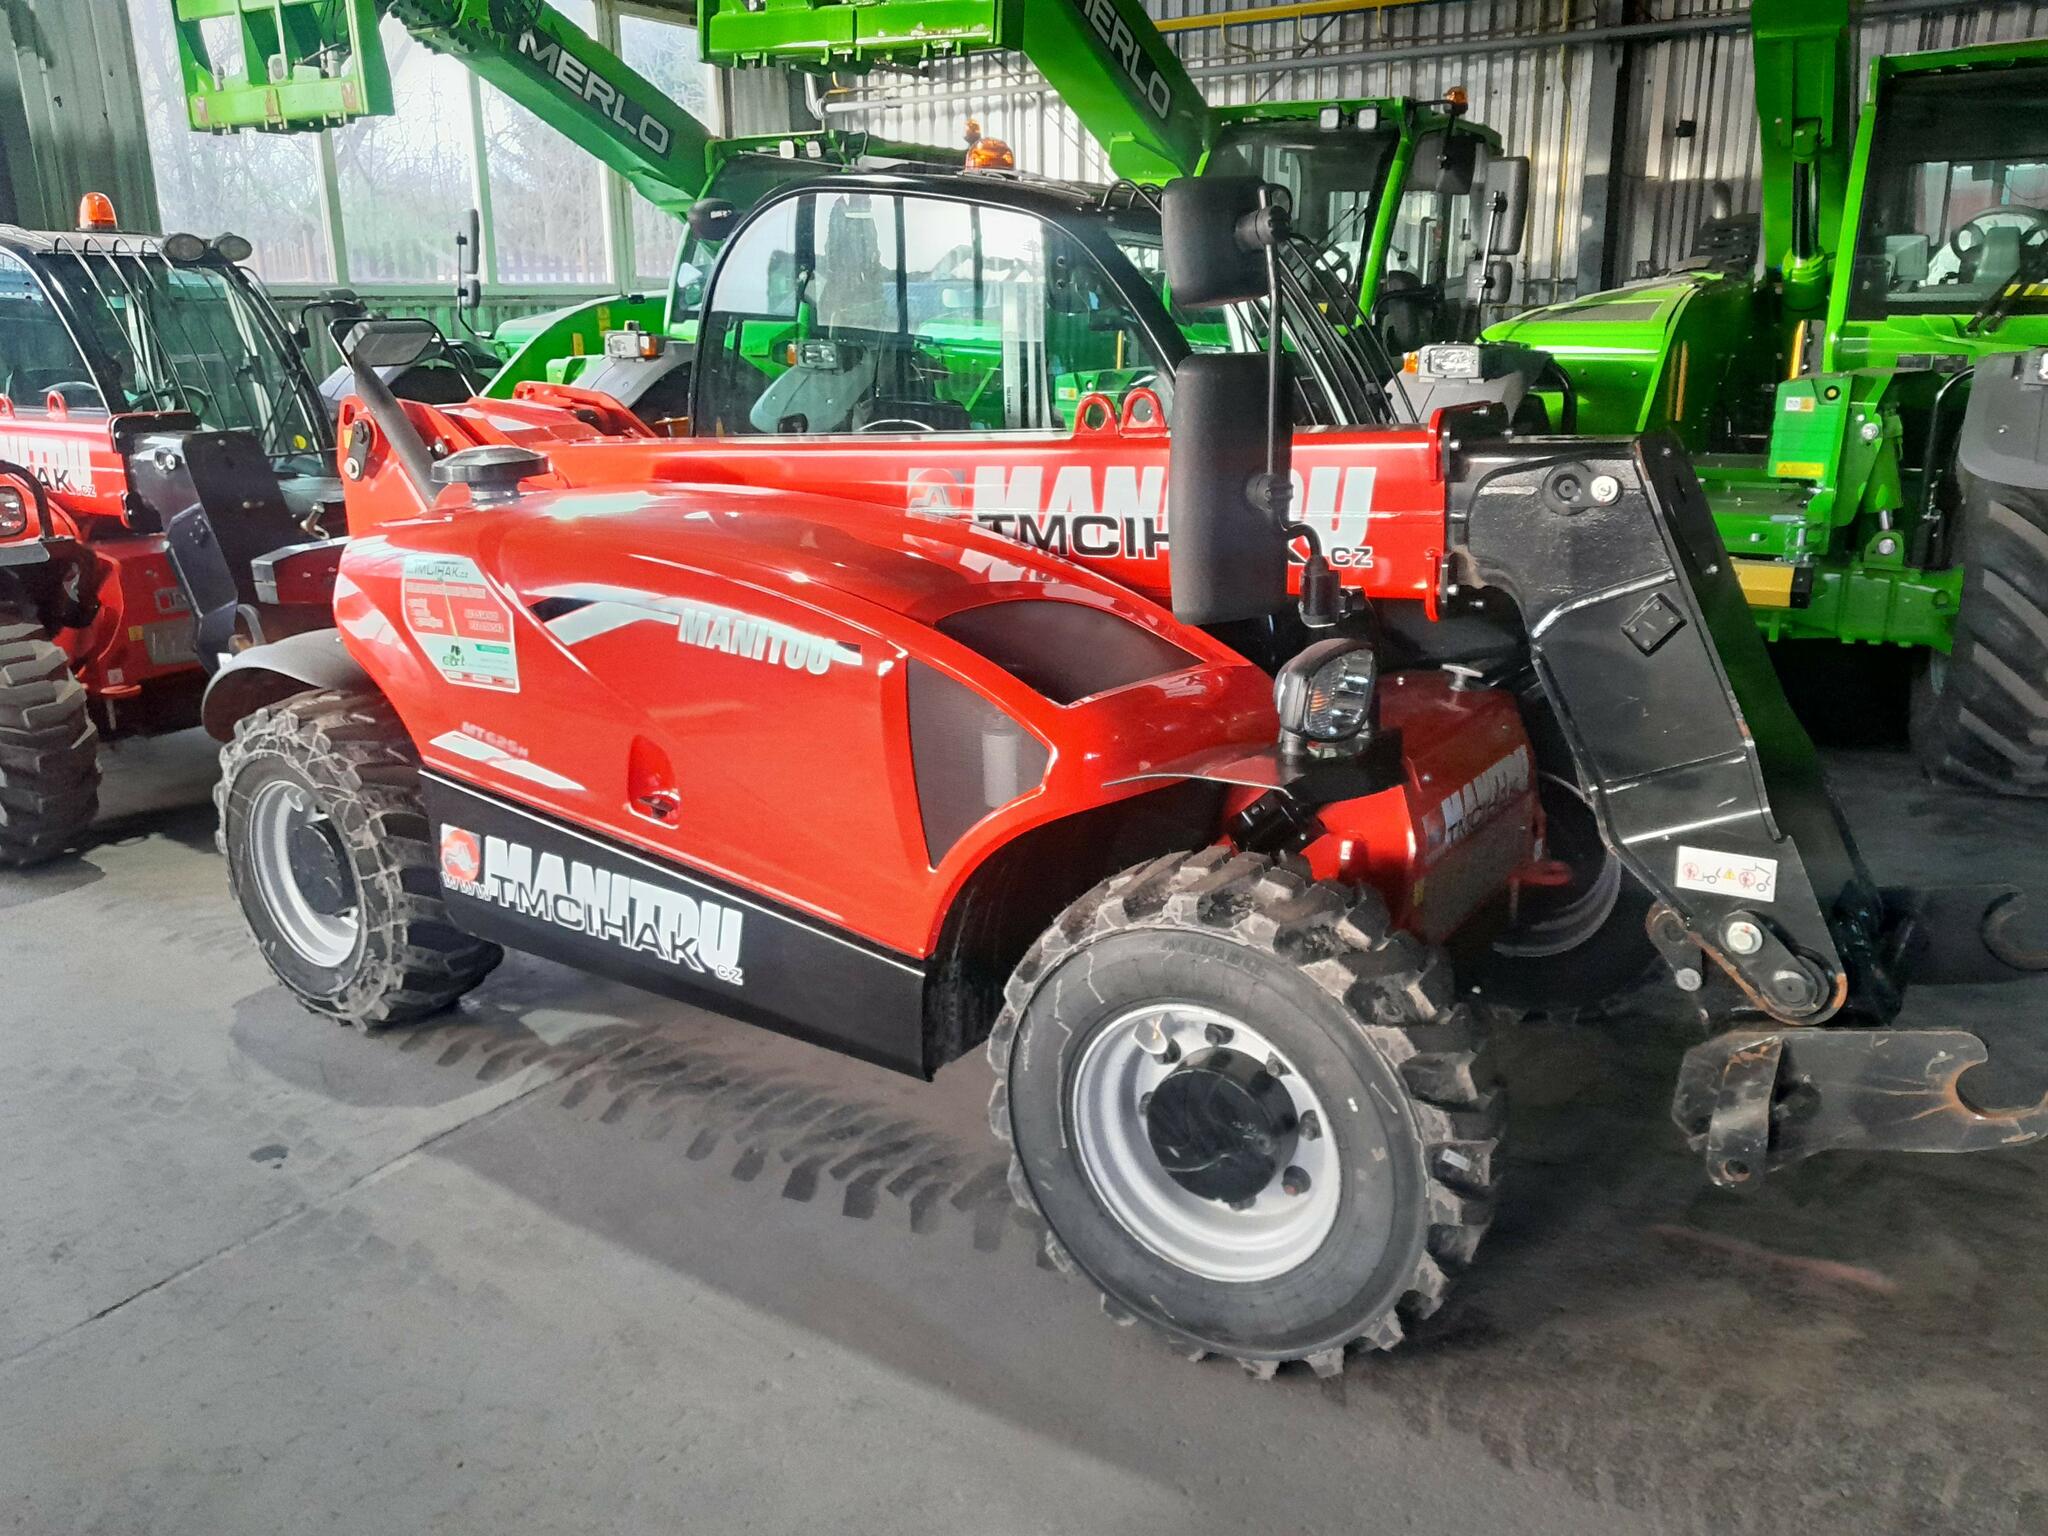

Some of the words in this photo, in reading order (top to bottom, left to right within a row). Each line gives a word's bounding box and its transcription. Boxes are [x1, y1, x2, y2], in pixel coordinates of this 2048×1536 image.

[518, 27, 670, 154] MERLO
[678, 606, 832, 676] MANITOU
[485, 834, 744, 972] MANITOU
